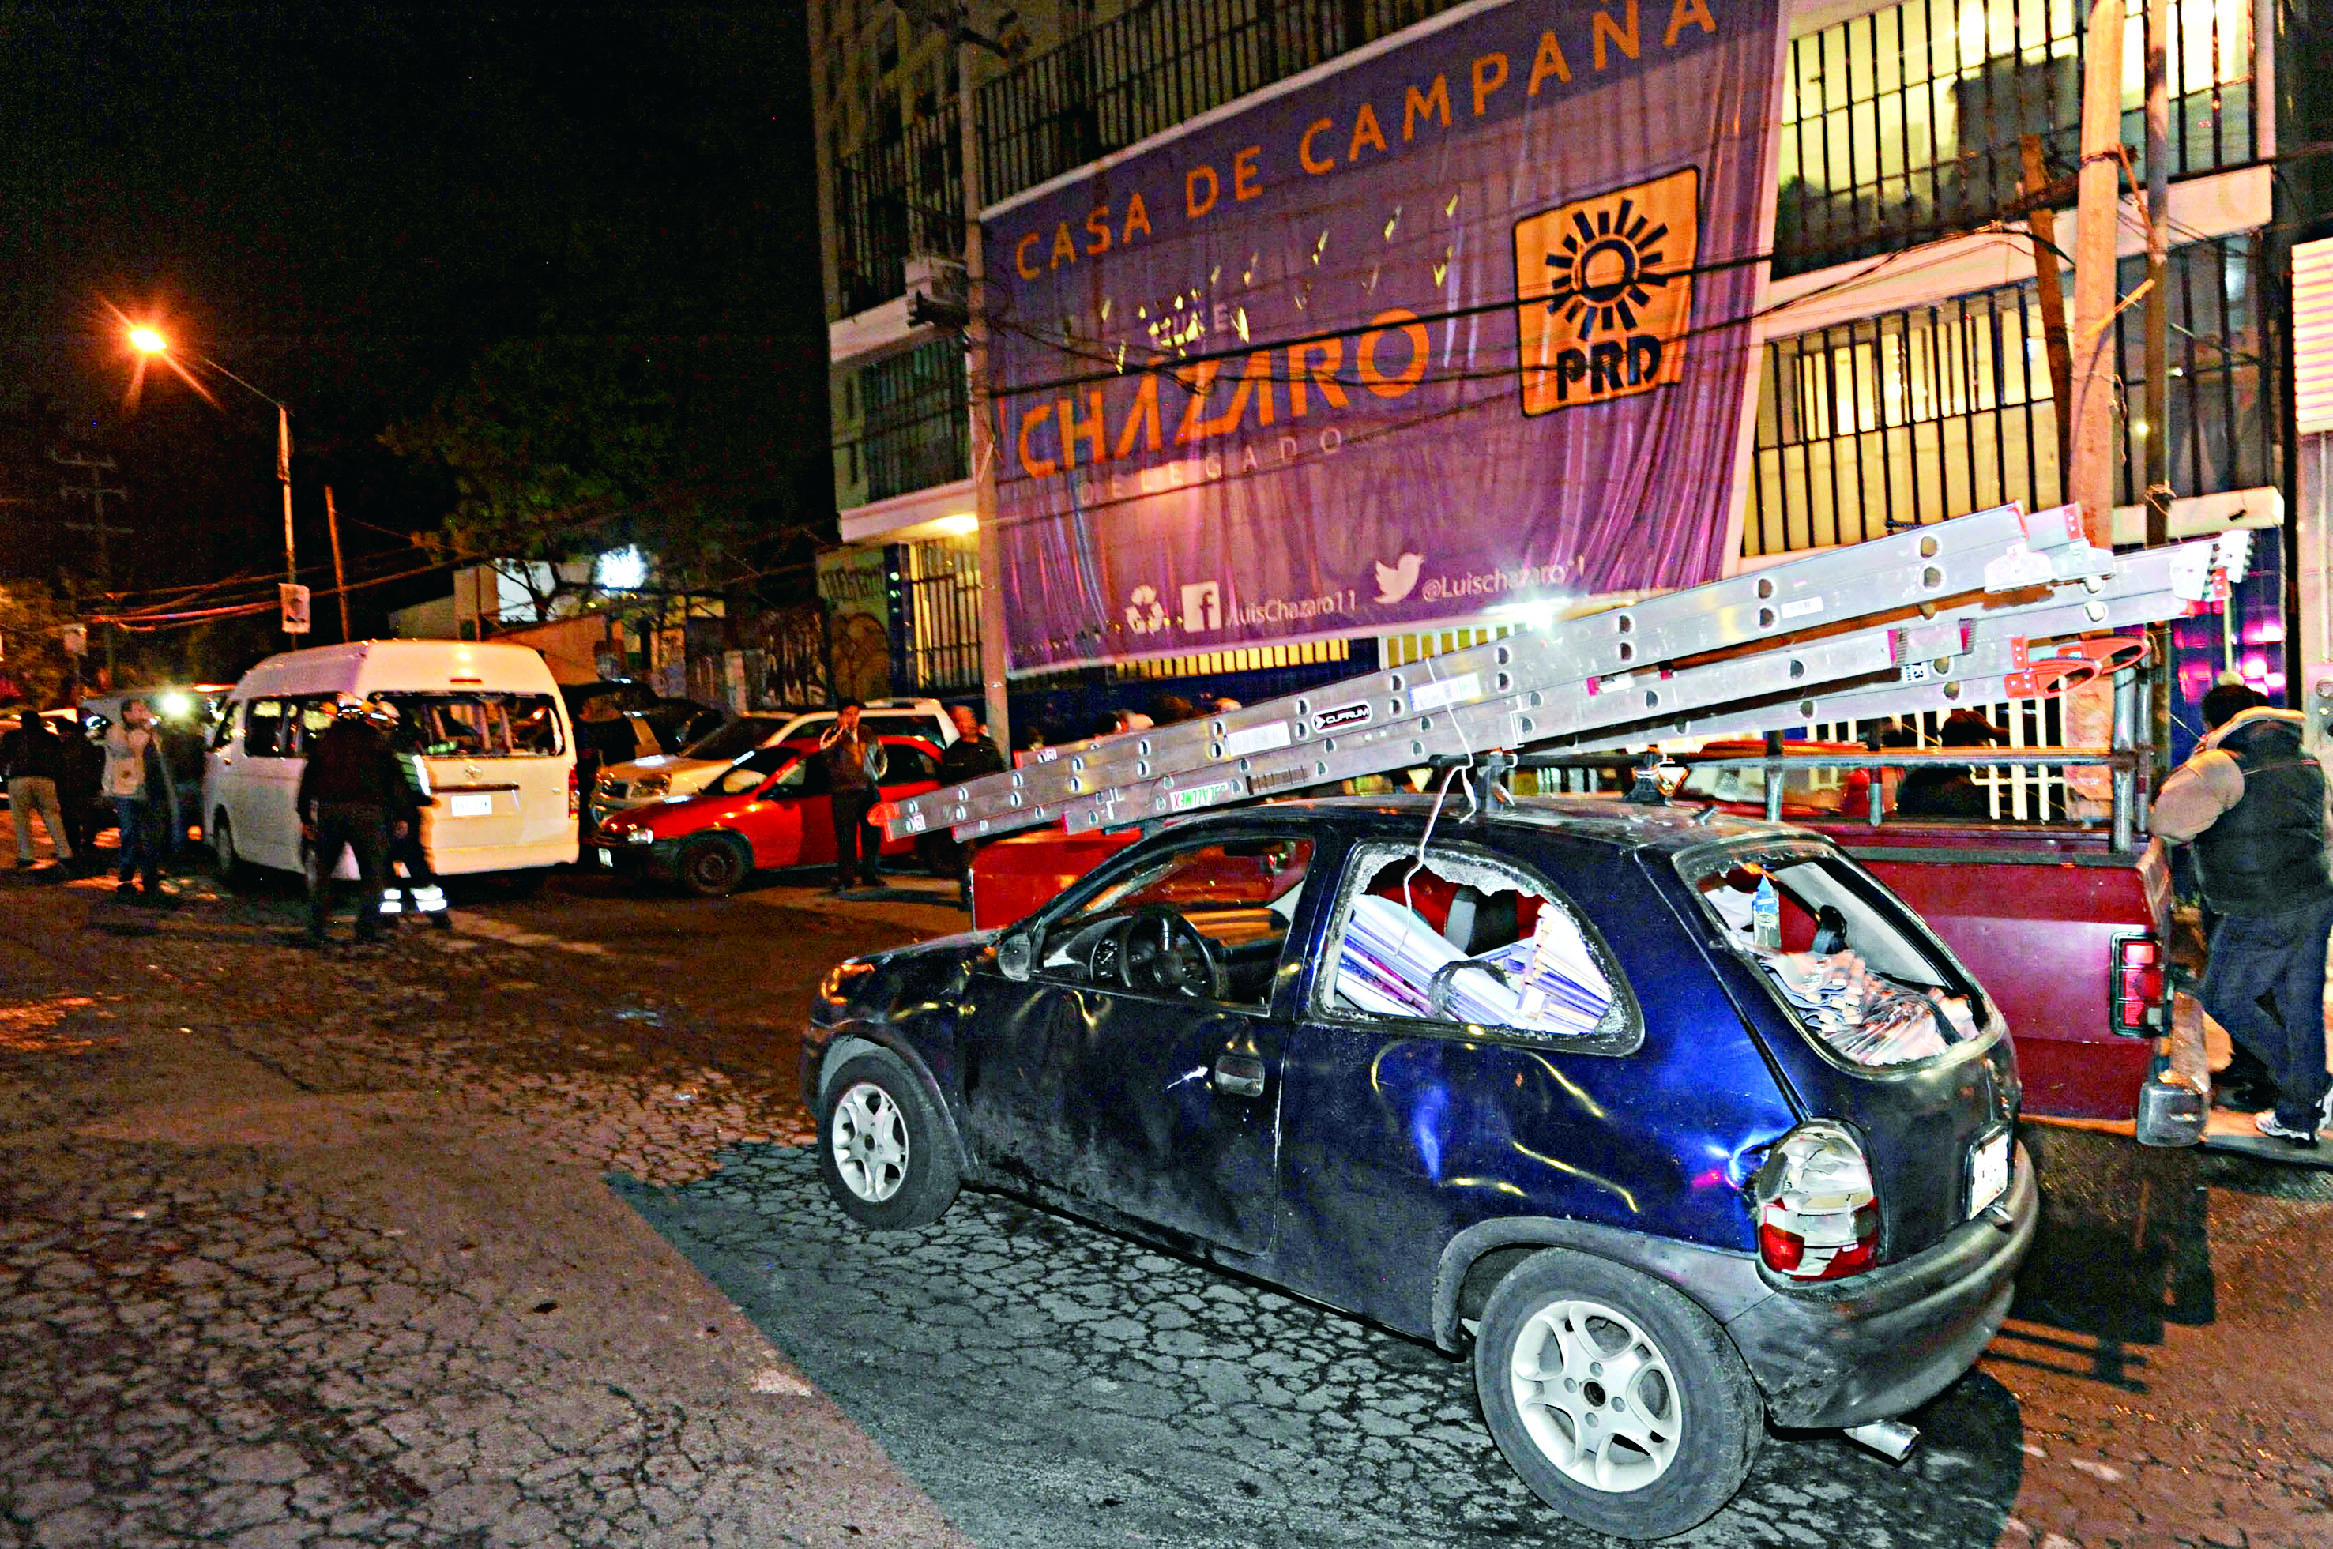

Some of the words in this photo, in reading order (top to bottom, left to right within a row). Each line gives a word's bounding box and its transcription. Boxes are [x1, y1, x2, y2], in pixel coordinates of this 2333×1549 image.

[1015, 192, 1151, 280] CASA
[1186, 145, 1263, 219] DE
[1556, 336, 1661, 401] PRD
[1079, 426, 1342, 506] DELEGADO
